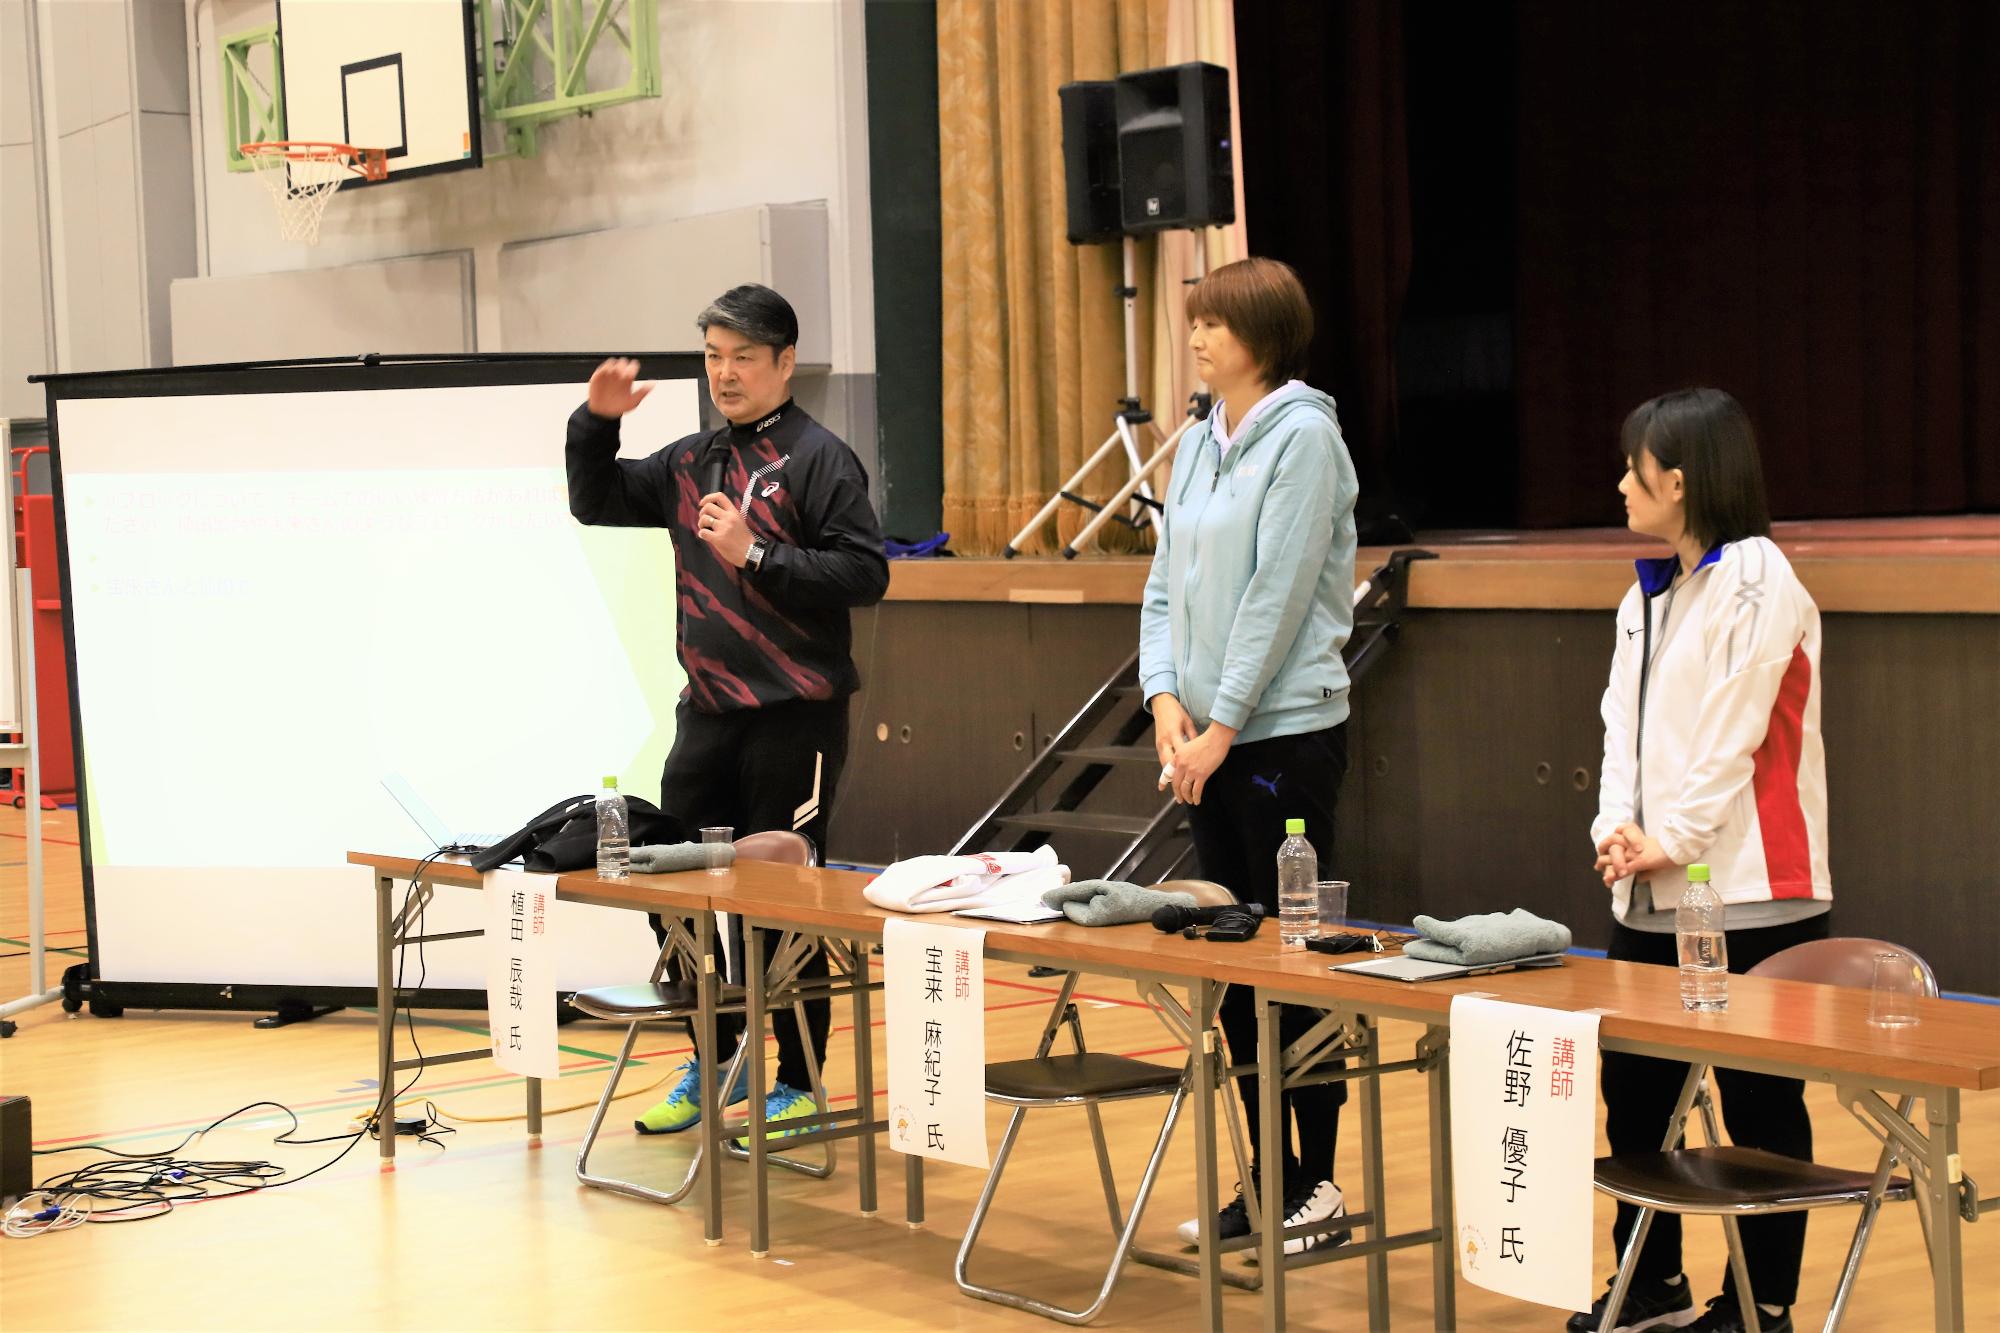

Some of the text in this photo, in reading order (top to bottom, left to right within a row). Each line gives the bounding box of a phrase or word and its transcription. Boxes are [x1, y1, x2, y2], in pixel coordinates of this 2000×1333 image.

[510, 890, 526, 1051] 植田 辰哉 氏
[533, 893, 545, 936] 講師
[955, 950, 970, 1001] 講師
[925, 946, 945, 1151] 宝来 麻紀子 氏
[1550, 1037, 1576, 1101] 講師
[1499, 1029, 1535, 1265] 佐野 優子 氏
